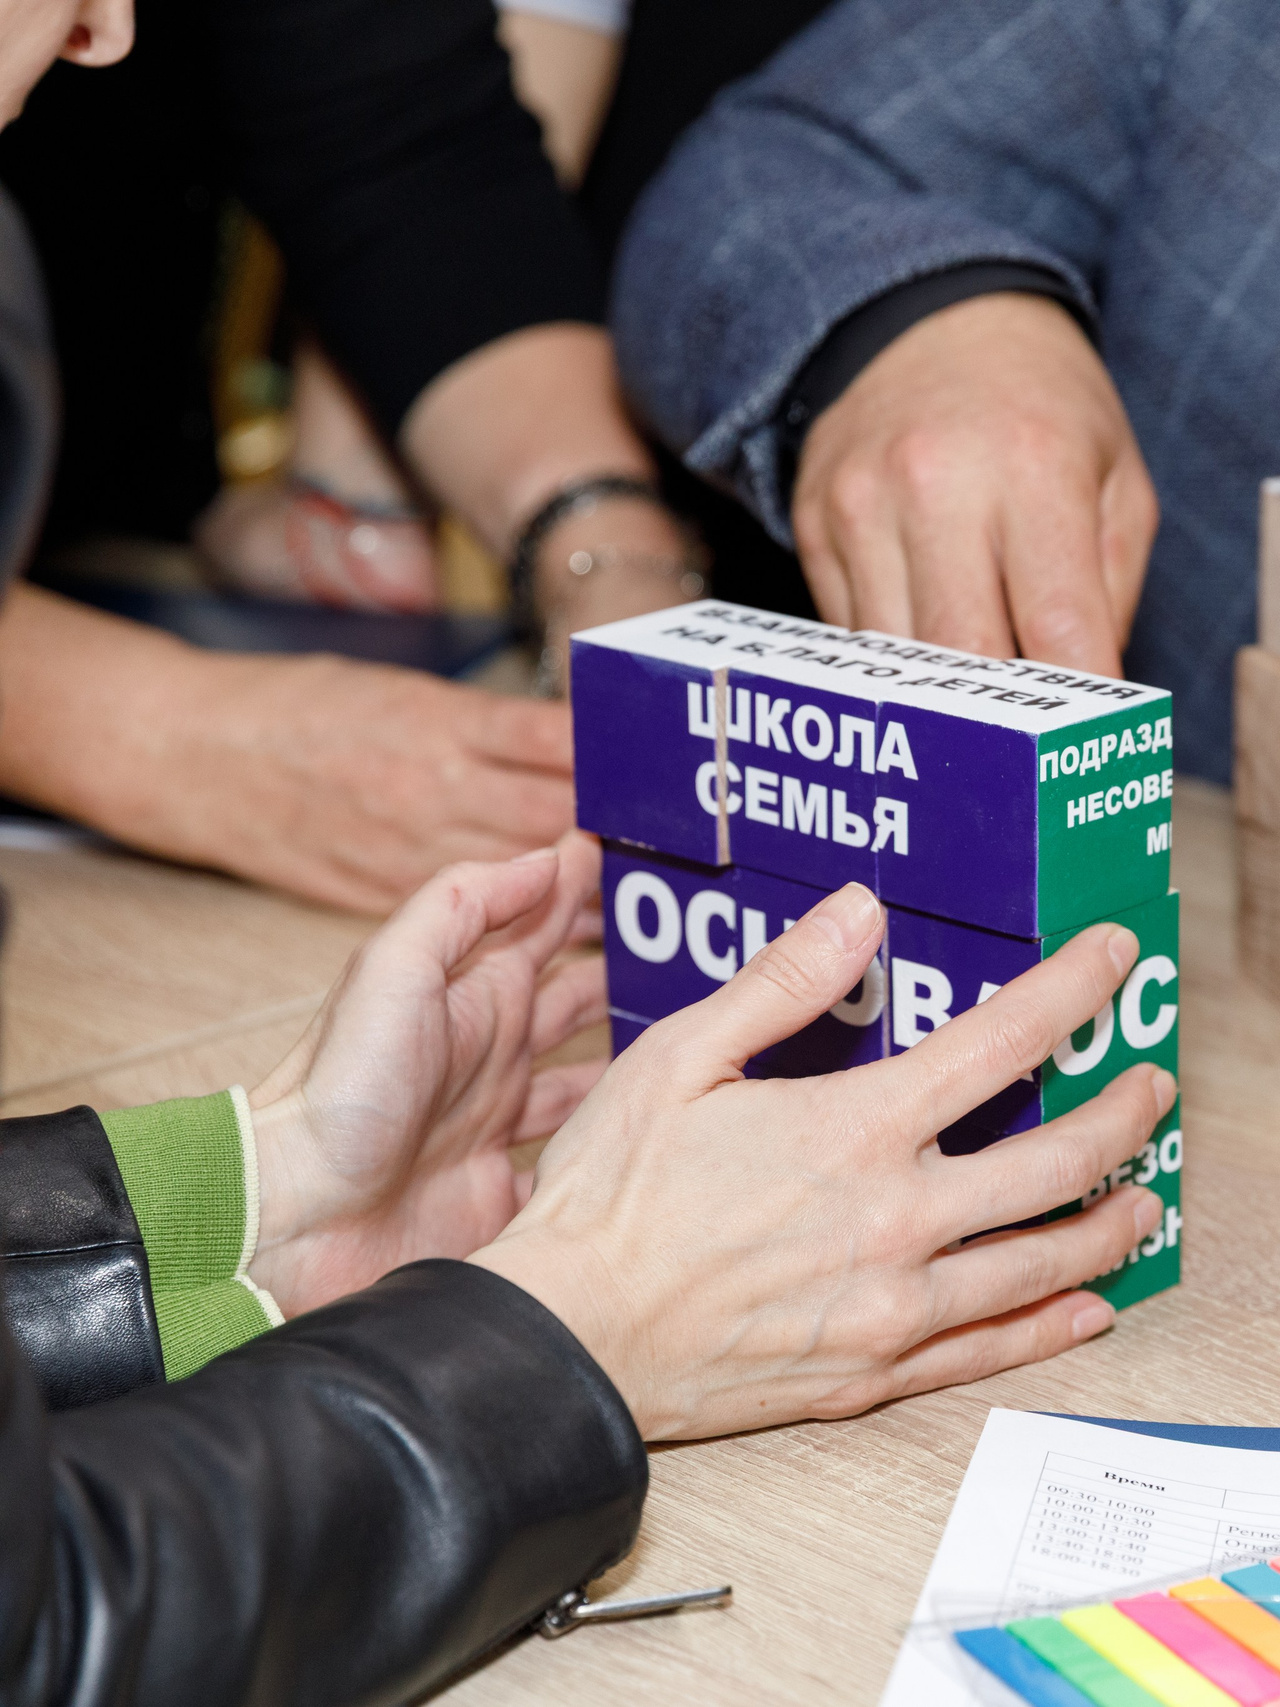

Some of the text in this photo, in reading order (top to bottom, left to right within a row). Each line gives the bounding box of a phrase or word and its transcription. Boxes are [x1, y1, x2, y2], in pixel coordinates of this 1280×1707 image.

[662, 626, 727, 645] НА
[898, 676, 1070, 710] ДЕТЕЙ
[687, 682, 918, 781] ШКОЛА
[1039, 716, 1173, 783] ПОДРАЗД
[695, 761, 909, 856] СЕМЬЯ
[1067, 768, 1173, 828] НЕСОВЕ
[1046, 1497, 1152, 1529] 10:00-10:30
[1047, 1485, 1155, 1517] 09:30-10:00
[1104, 1472, 1165, 1491] Время
